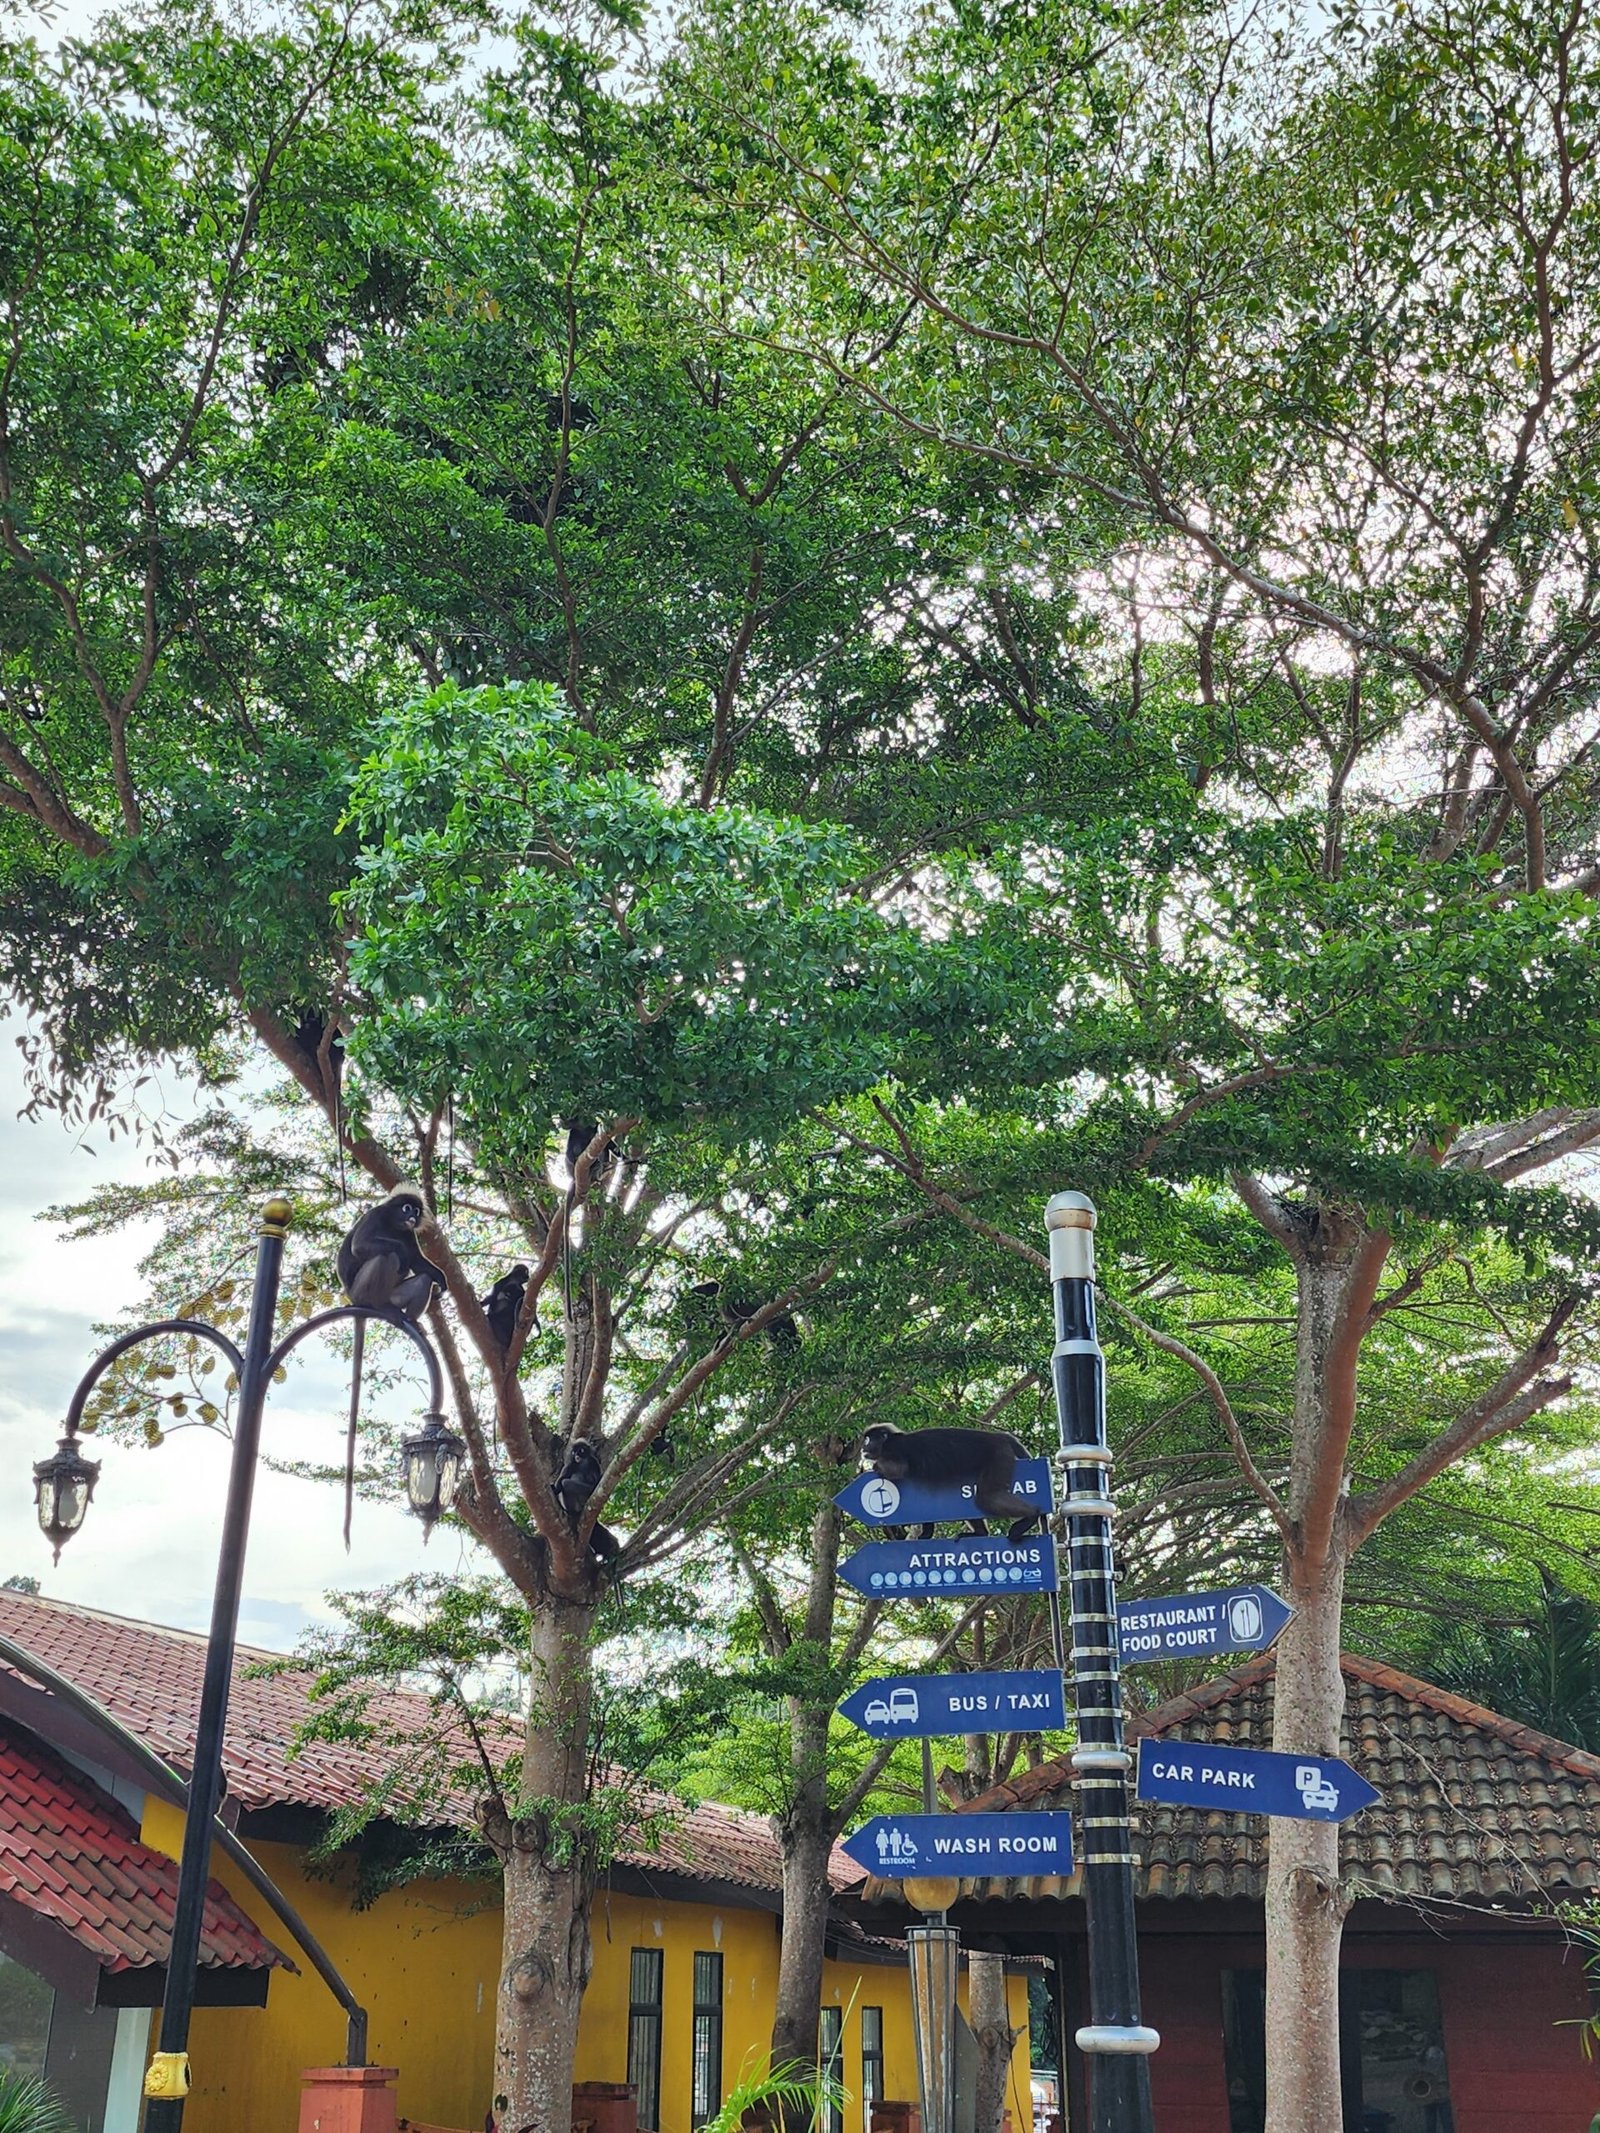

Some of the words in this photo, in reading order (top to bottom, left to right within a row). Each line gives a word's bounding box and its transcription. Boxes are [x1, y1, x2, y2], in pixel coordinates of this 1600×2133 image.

[909, 1549, 1041, 1568] ATTRACTIONS
[1121, 1605, 1217, 1631] RESTAURANT
[1122, 1634, 1162, 1653] FOOD
[1165, 1628, 1218, 1649] COURT
[949, 1696, 988, 1712] BUS
[994, 1695, 1000, 1710] /
[1007, 1693, 1050, 1709] TAXI
[1152, 1763, 1194, 1782] CAR
[1201, 1768, 1255, 1789] PARK
[934, 1838, 991, 1854] WASH
[998, 1836, 1057, 1853] ROOM
[879, 1857, 916, 1865] RESTROOM
